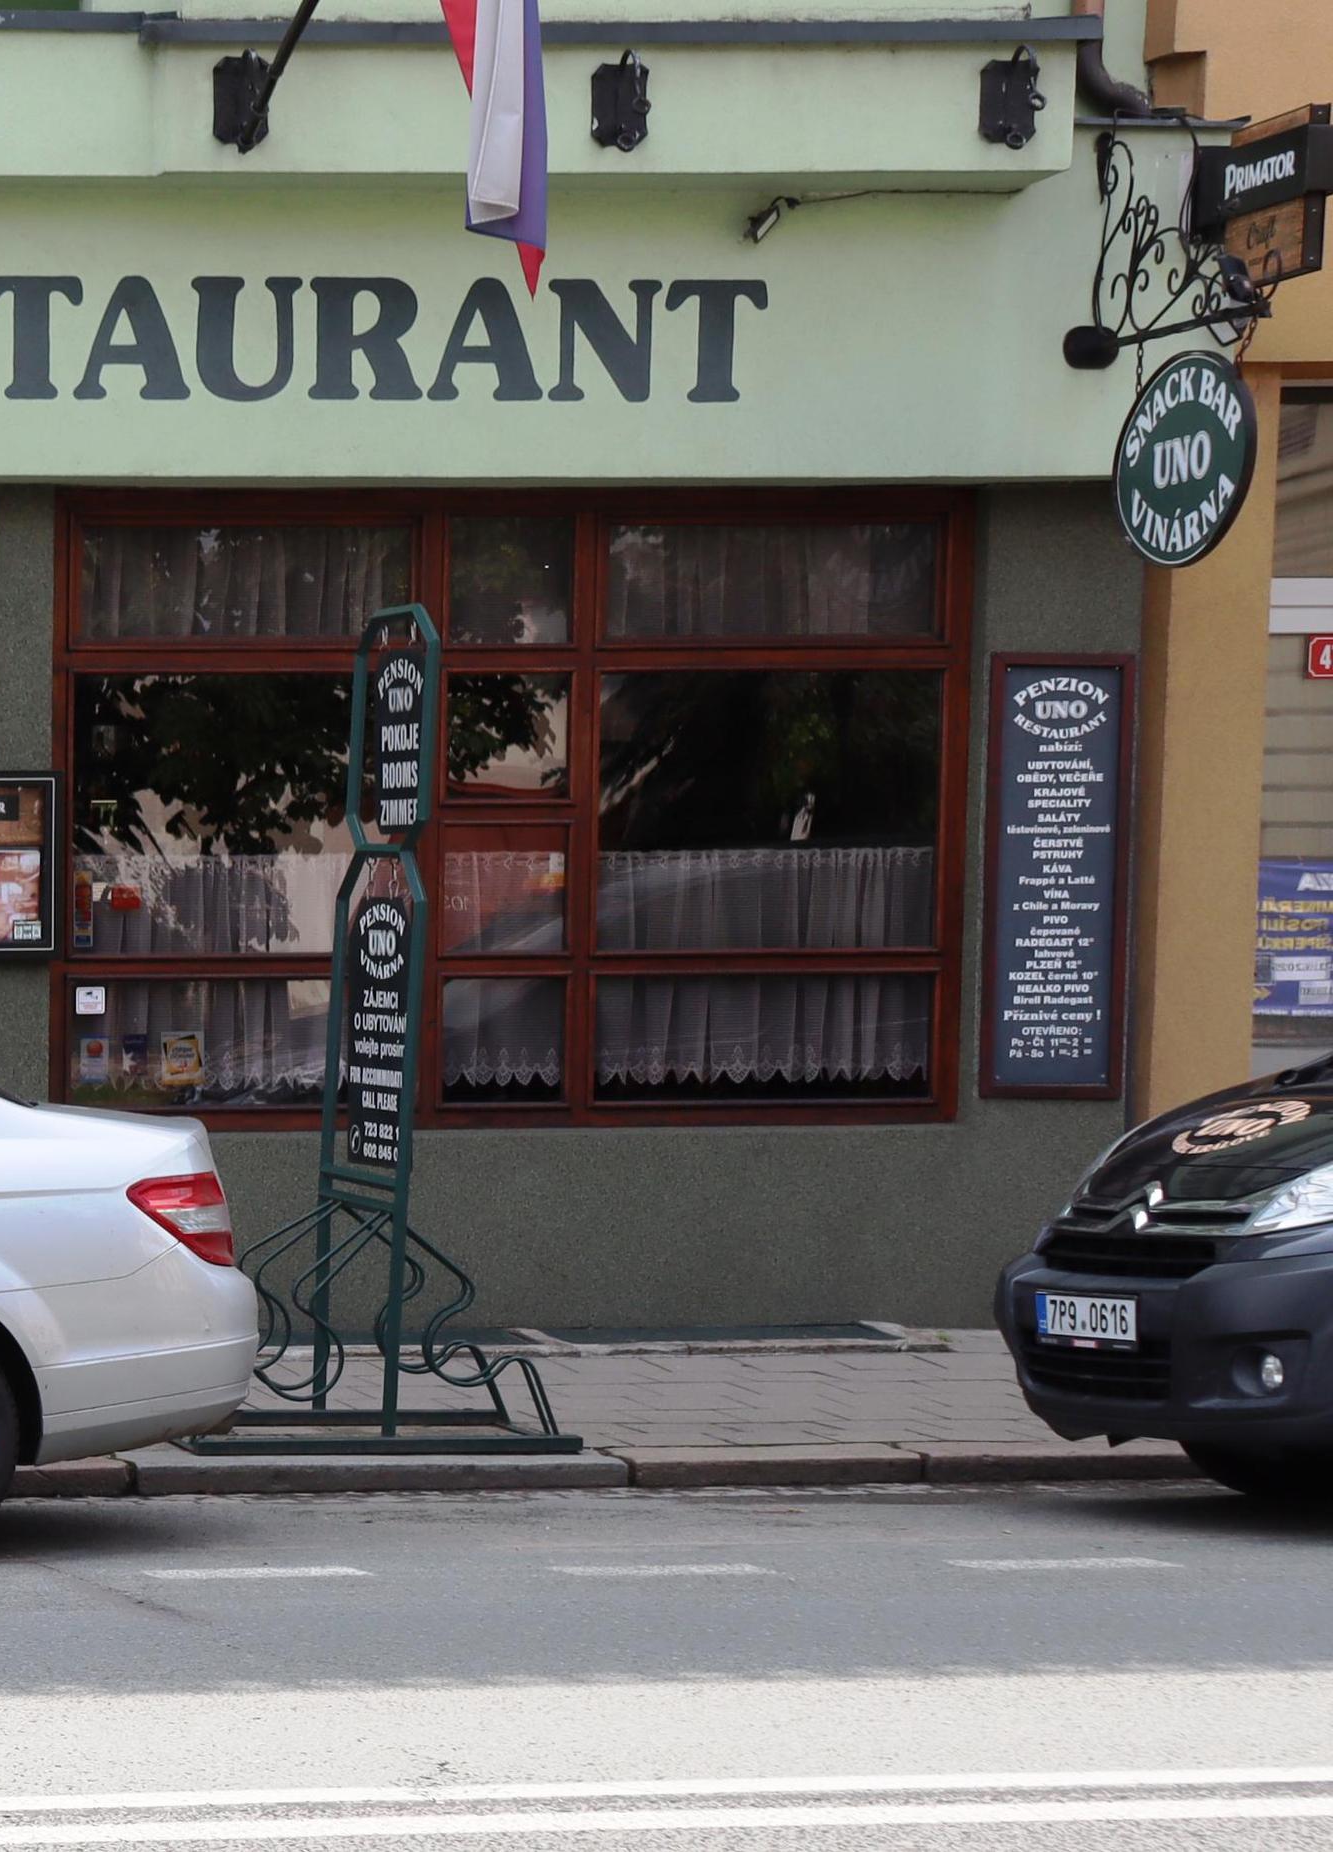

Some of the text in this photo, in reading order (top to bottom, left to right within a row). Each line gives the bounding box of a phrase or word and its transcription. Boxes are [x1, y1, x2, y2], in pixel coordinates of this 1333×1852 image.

[1224, 150, 1295, 200] PRIMATOR
[1126, 366, 1244, 469] SNACK BAR
[1152, 429, 1211, 489] UNO
[1132, 473, 1235, 553] VINÁRNA
[377, 657, 424, 700] PENSION
[1013, 677, 1110, 707] PENZION
[387, 685, 413, 714] UNO
[1034, 700, 1088, 719] UNO
[1013, 711, 1108, 739] RESTAURANT
[381, 722, 419, 752] POKOJE
[1039, 741, 1082, 752] nabízí:
[1027, 758, 1093, 770] UBYTOVÁNÍ,
[382, 760, 418, 790] ROOMS
[1016, 771, 1104, 783] OBĚDY, VEČEŘE
[1033, 786, 1086, 797] KRAJOVÉ
[1027, 798, 1092, 808] SPECIALITY
[1037, 812, 1081, 823] SALÁTY
[1007, 824, 1111, 835] těstovinové, zeleninové
[1033, 837, 1083, 848] ČERSTVÉ
[1033, 849, 1084, 860] PSTRUHY
[1042, 863, 1073, 873] KÁVA
[1018, 876, 1056, 886] Frappé
[1043, 888, 1070, 899] VÍNA
[1022, 902, 1049, 911] Chile
[1061, 902, 1100, 912] Moravy
[359, 903, 405, 937] PENSION
[1042, 915, 1068, 925] PIVO
[1030, 926, 1081, 937] čepované
[368, 930, 396, 957] UNO
[1015, 938, 1074, 947] RADEGAST
[1034, 949, 1075, 959] lahvové
[359, 949, 404, 980] VINÁRNA
[1026, 959, 1062, 969] PLZEŇ
[1009, 971, 1045, 981] KOZEL
[1017, 983, 1090, 993] NEALKO PIVO
[363, 987, 399, 1009] ZÁJEMCI
[1013, 995, 1093, 1006] Birell Radegast
[354, 1012, 361, 1030] O
[1003, 1009, 1059, 1021] Příznivé
[1062, 1011, 1093, 1022] ceny
[1021, 1025, 1082, 1035] OTEVŘENO:
[354, 1037, 379, 1058] volejte
[1011, 1038, 1024, 1047] Po
[1033, 1036, 1044, 1047] Čt
[1009, 1049, 1022, 1058] Pá
[1031, 1049, 1044, 1058] So
[361, 1090, 398, 1112] CALL PLEASE
[364, 1121, 378, 1138] 723
[379, 1123, 394, 1140] 822
[363, 1142, 377, 1159] 602
[378, 1144, 392, 1161] 845
[1049, 1299, 1128, 1335] 7P9 0616
